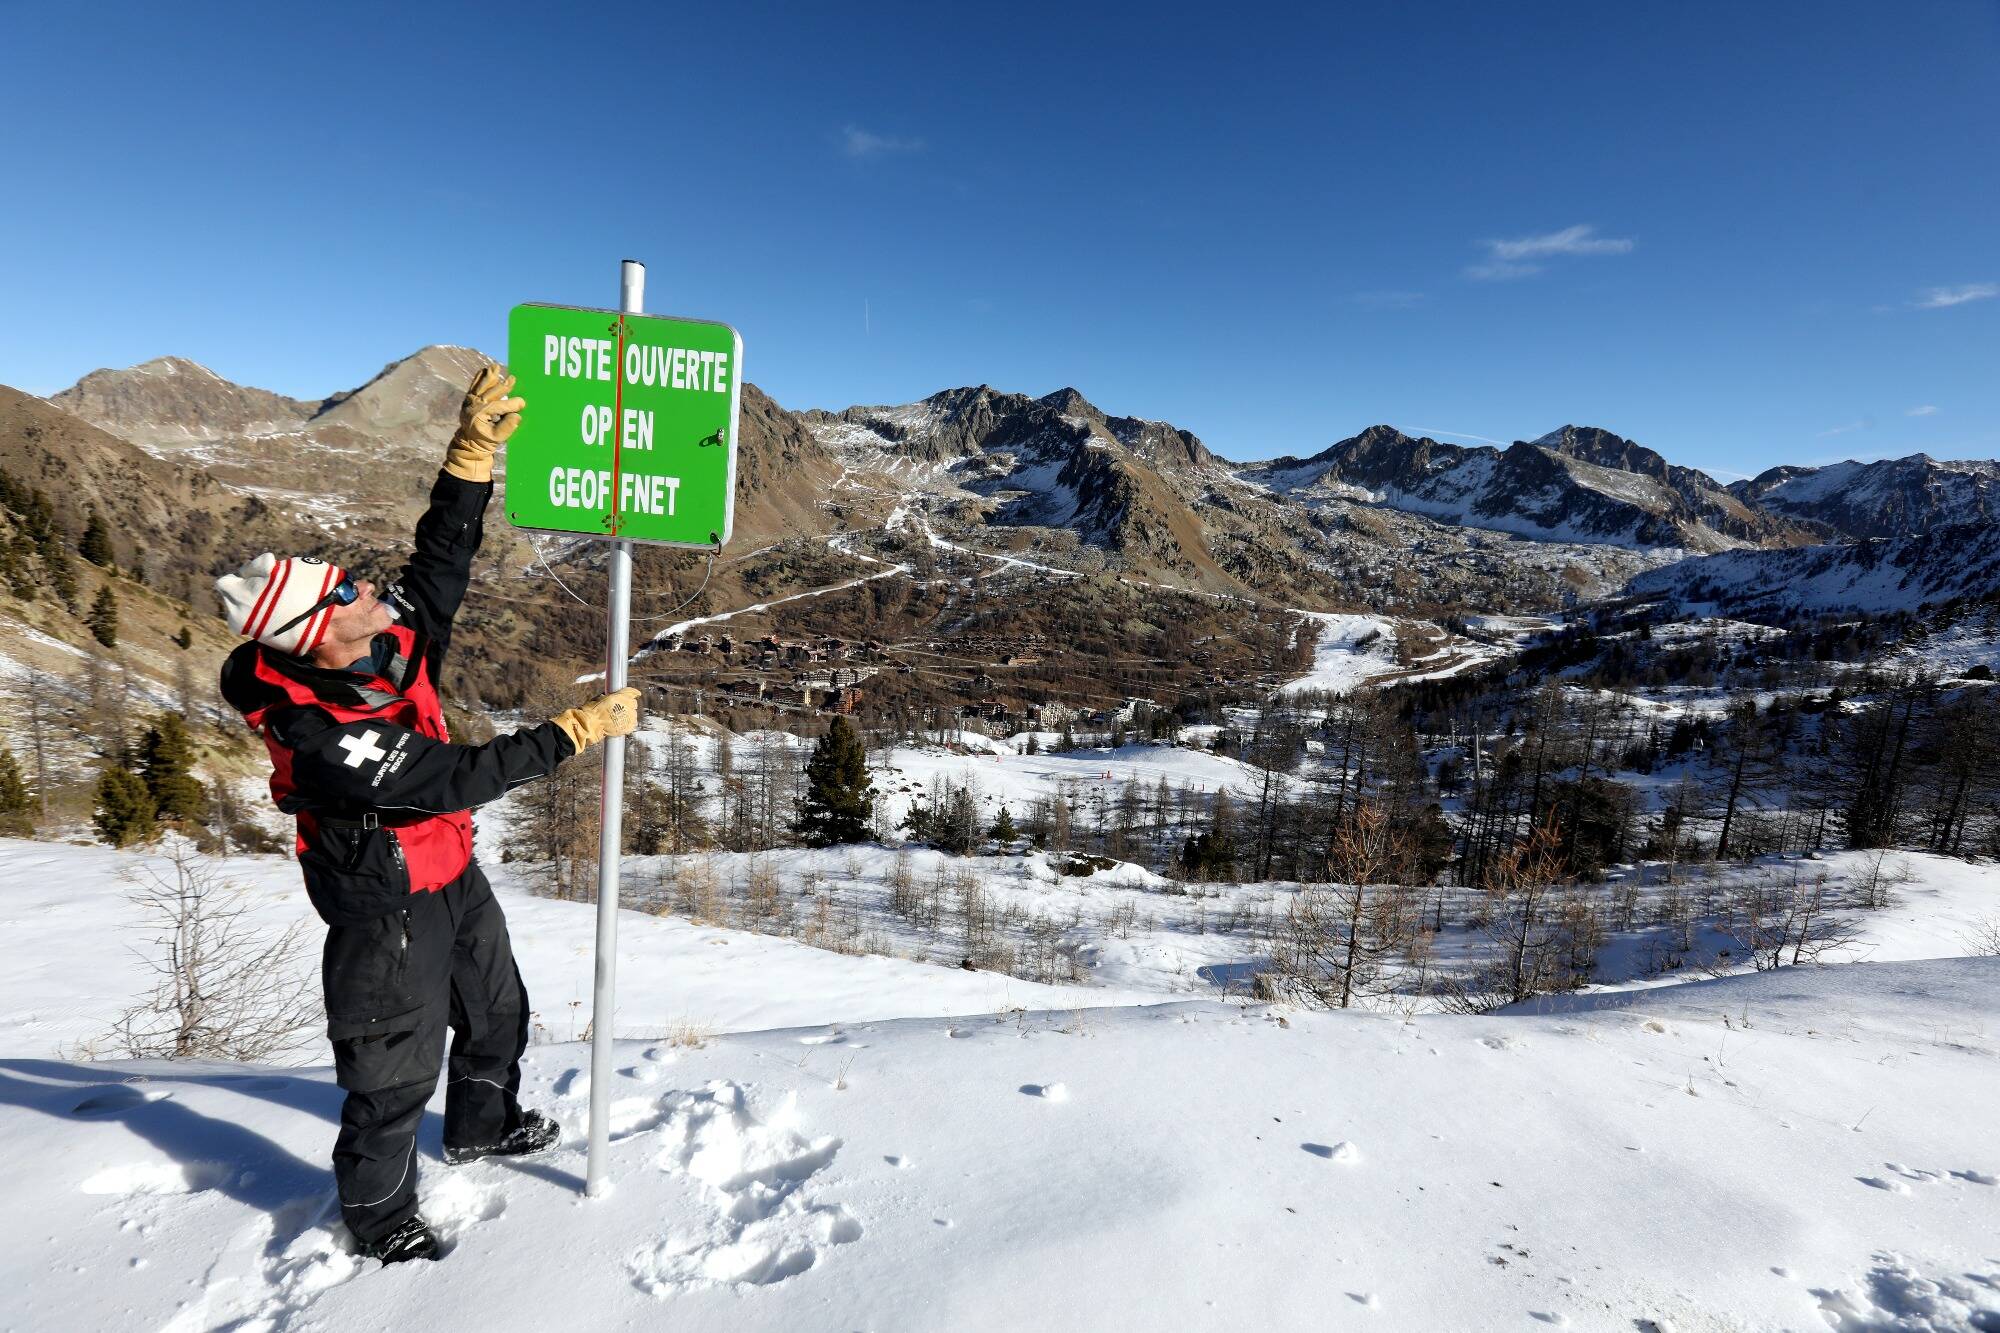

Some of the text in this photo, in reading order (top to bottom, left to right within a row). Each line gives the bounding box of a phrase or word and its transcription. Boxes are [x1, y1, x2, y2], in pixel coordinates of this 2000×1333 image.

[544, 334, 728, 393] PISTE OUVERTE
[388, 751, 408, 773] RESCUE
